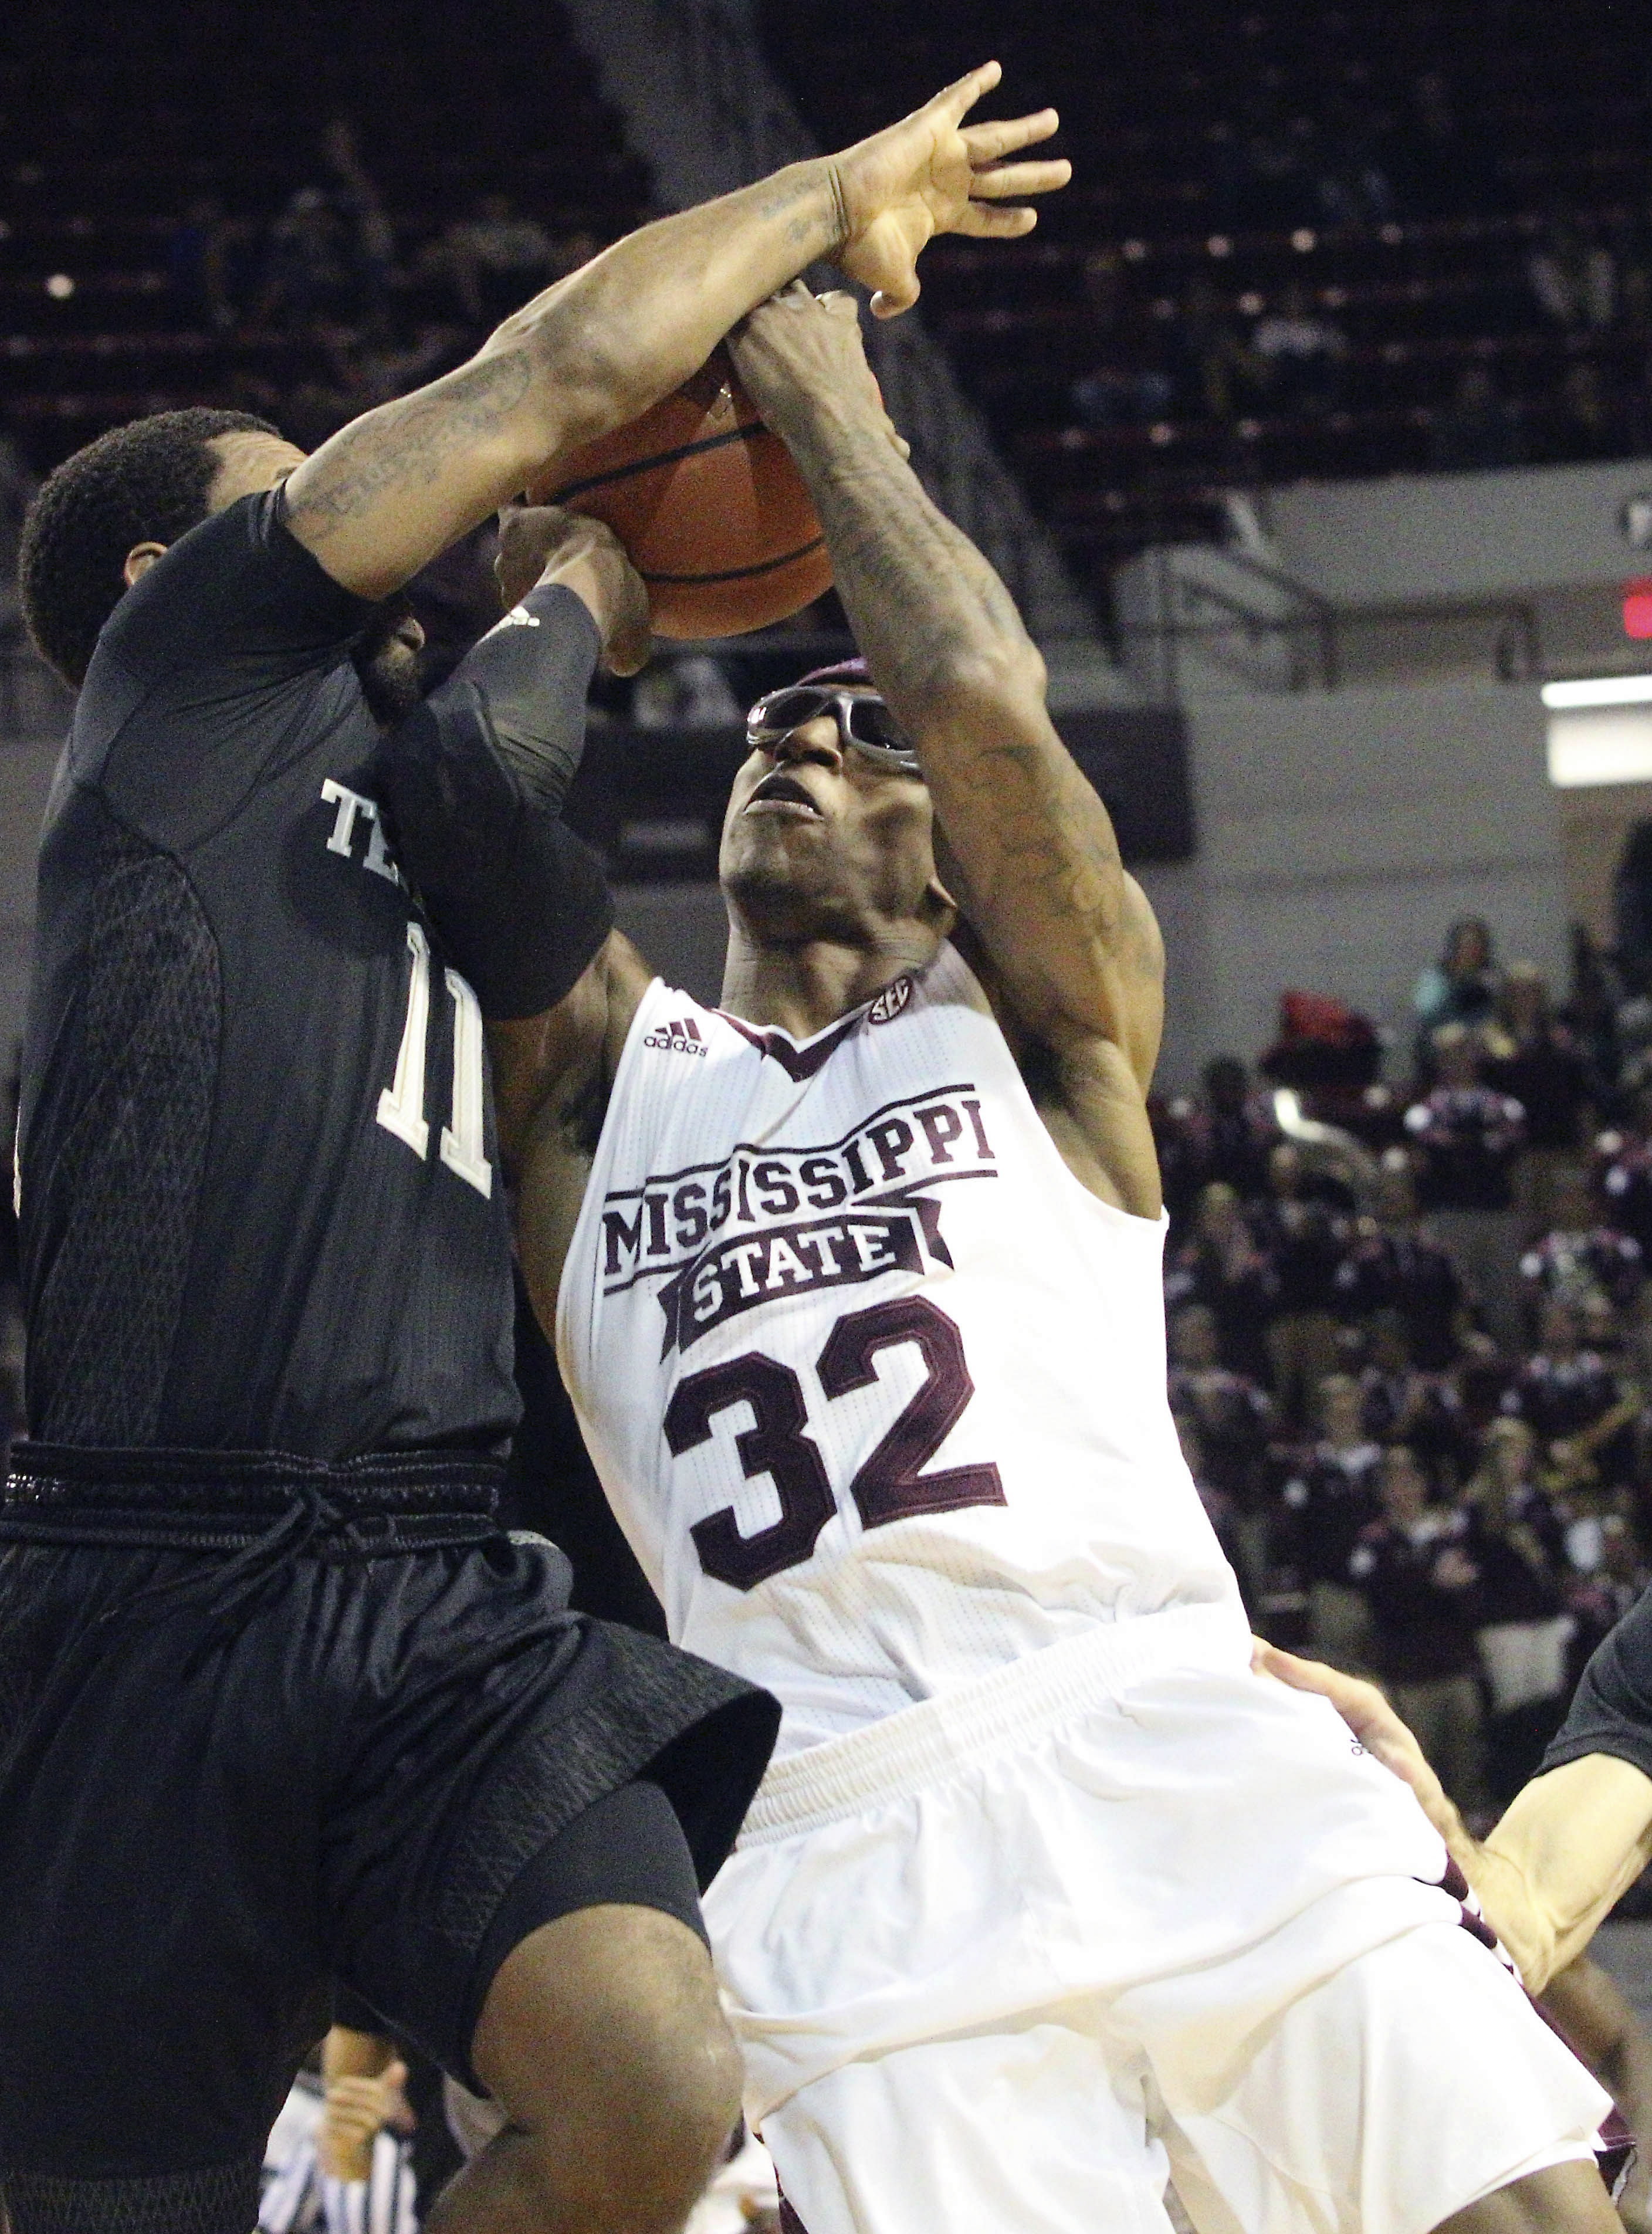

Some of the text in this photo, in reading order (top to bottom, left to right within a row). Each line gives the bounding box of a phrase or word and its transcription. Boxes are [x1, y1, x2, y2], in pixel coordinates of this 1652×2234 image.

[377, 920, 492, 1199] 11
[871, 979, 909, 1021] SEC
[603, 1099, 996, 1276] MISSISSIPPI
[692, 1224, 896, 1322] STATE
[663, 1294, 1008, 1592] 32
